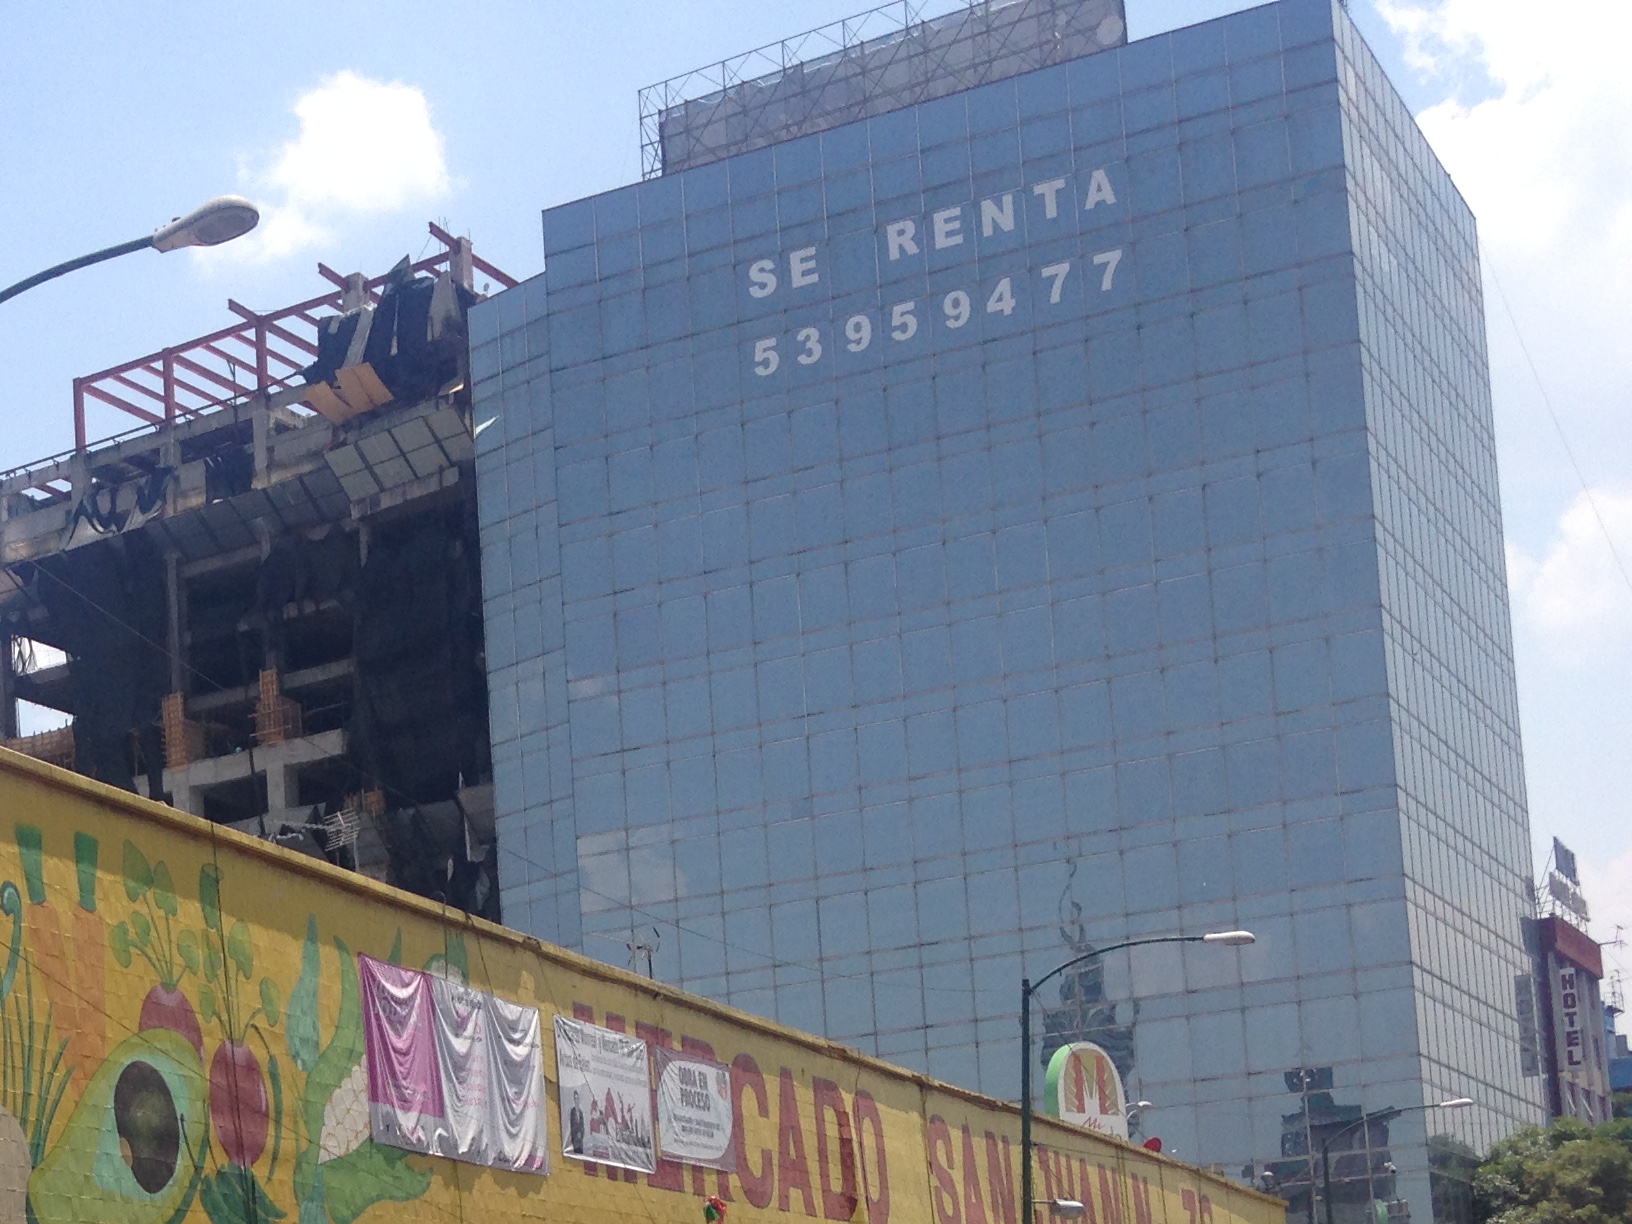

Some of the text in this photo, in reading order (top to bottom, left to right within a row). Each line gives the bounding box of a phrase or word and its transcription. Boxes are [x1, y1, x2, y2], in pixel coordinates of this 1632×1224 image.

[749, 169, 1117, 298] SE RENTA
[754, 249, 1123, 376] 53959477
[1560, 971, 1581, 1067] HOTEL
[680, 1087, 710, 1112] PROCESO
